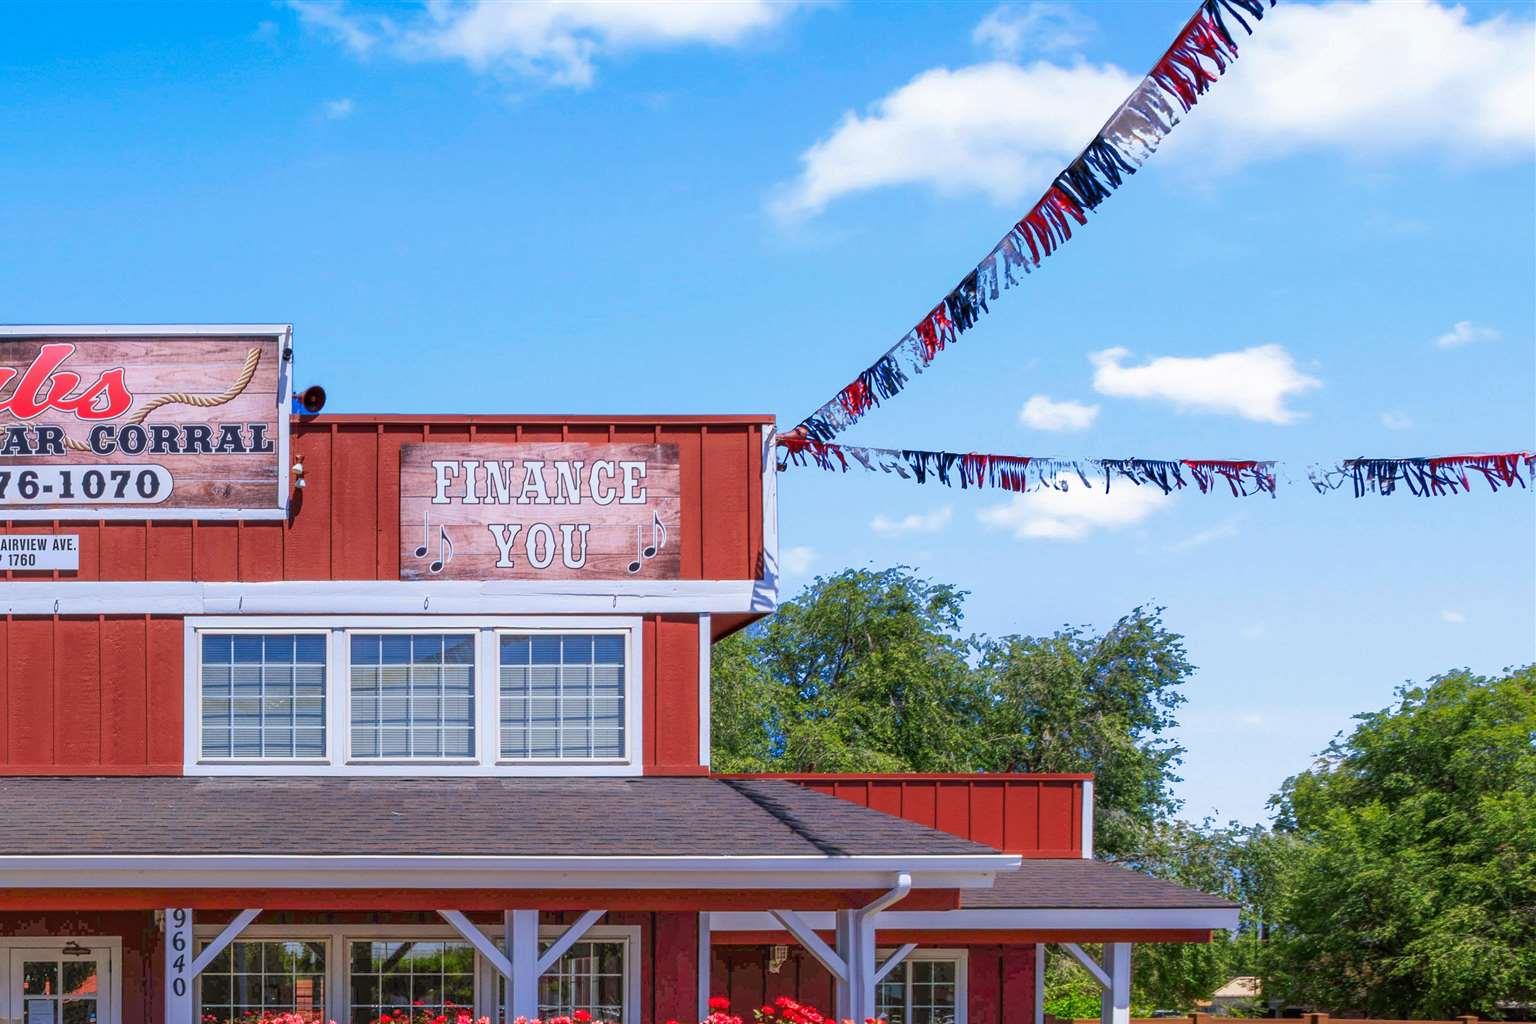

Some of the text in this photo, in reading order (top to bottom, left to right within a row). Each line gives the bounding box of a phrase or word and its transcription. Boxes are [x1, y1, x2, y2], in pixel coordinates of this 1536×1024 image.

[89, 423, 274, 456] CORRAL
[431, 459, 647, 505] FINANCE
[8, 554, 36, 566] 1760
[52, 538, 77, 551] AVE.
[488, 522, 590, 569] YOU
[172, 908, 186, 997] 9640
